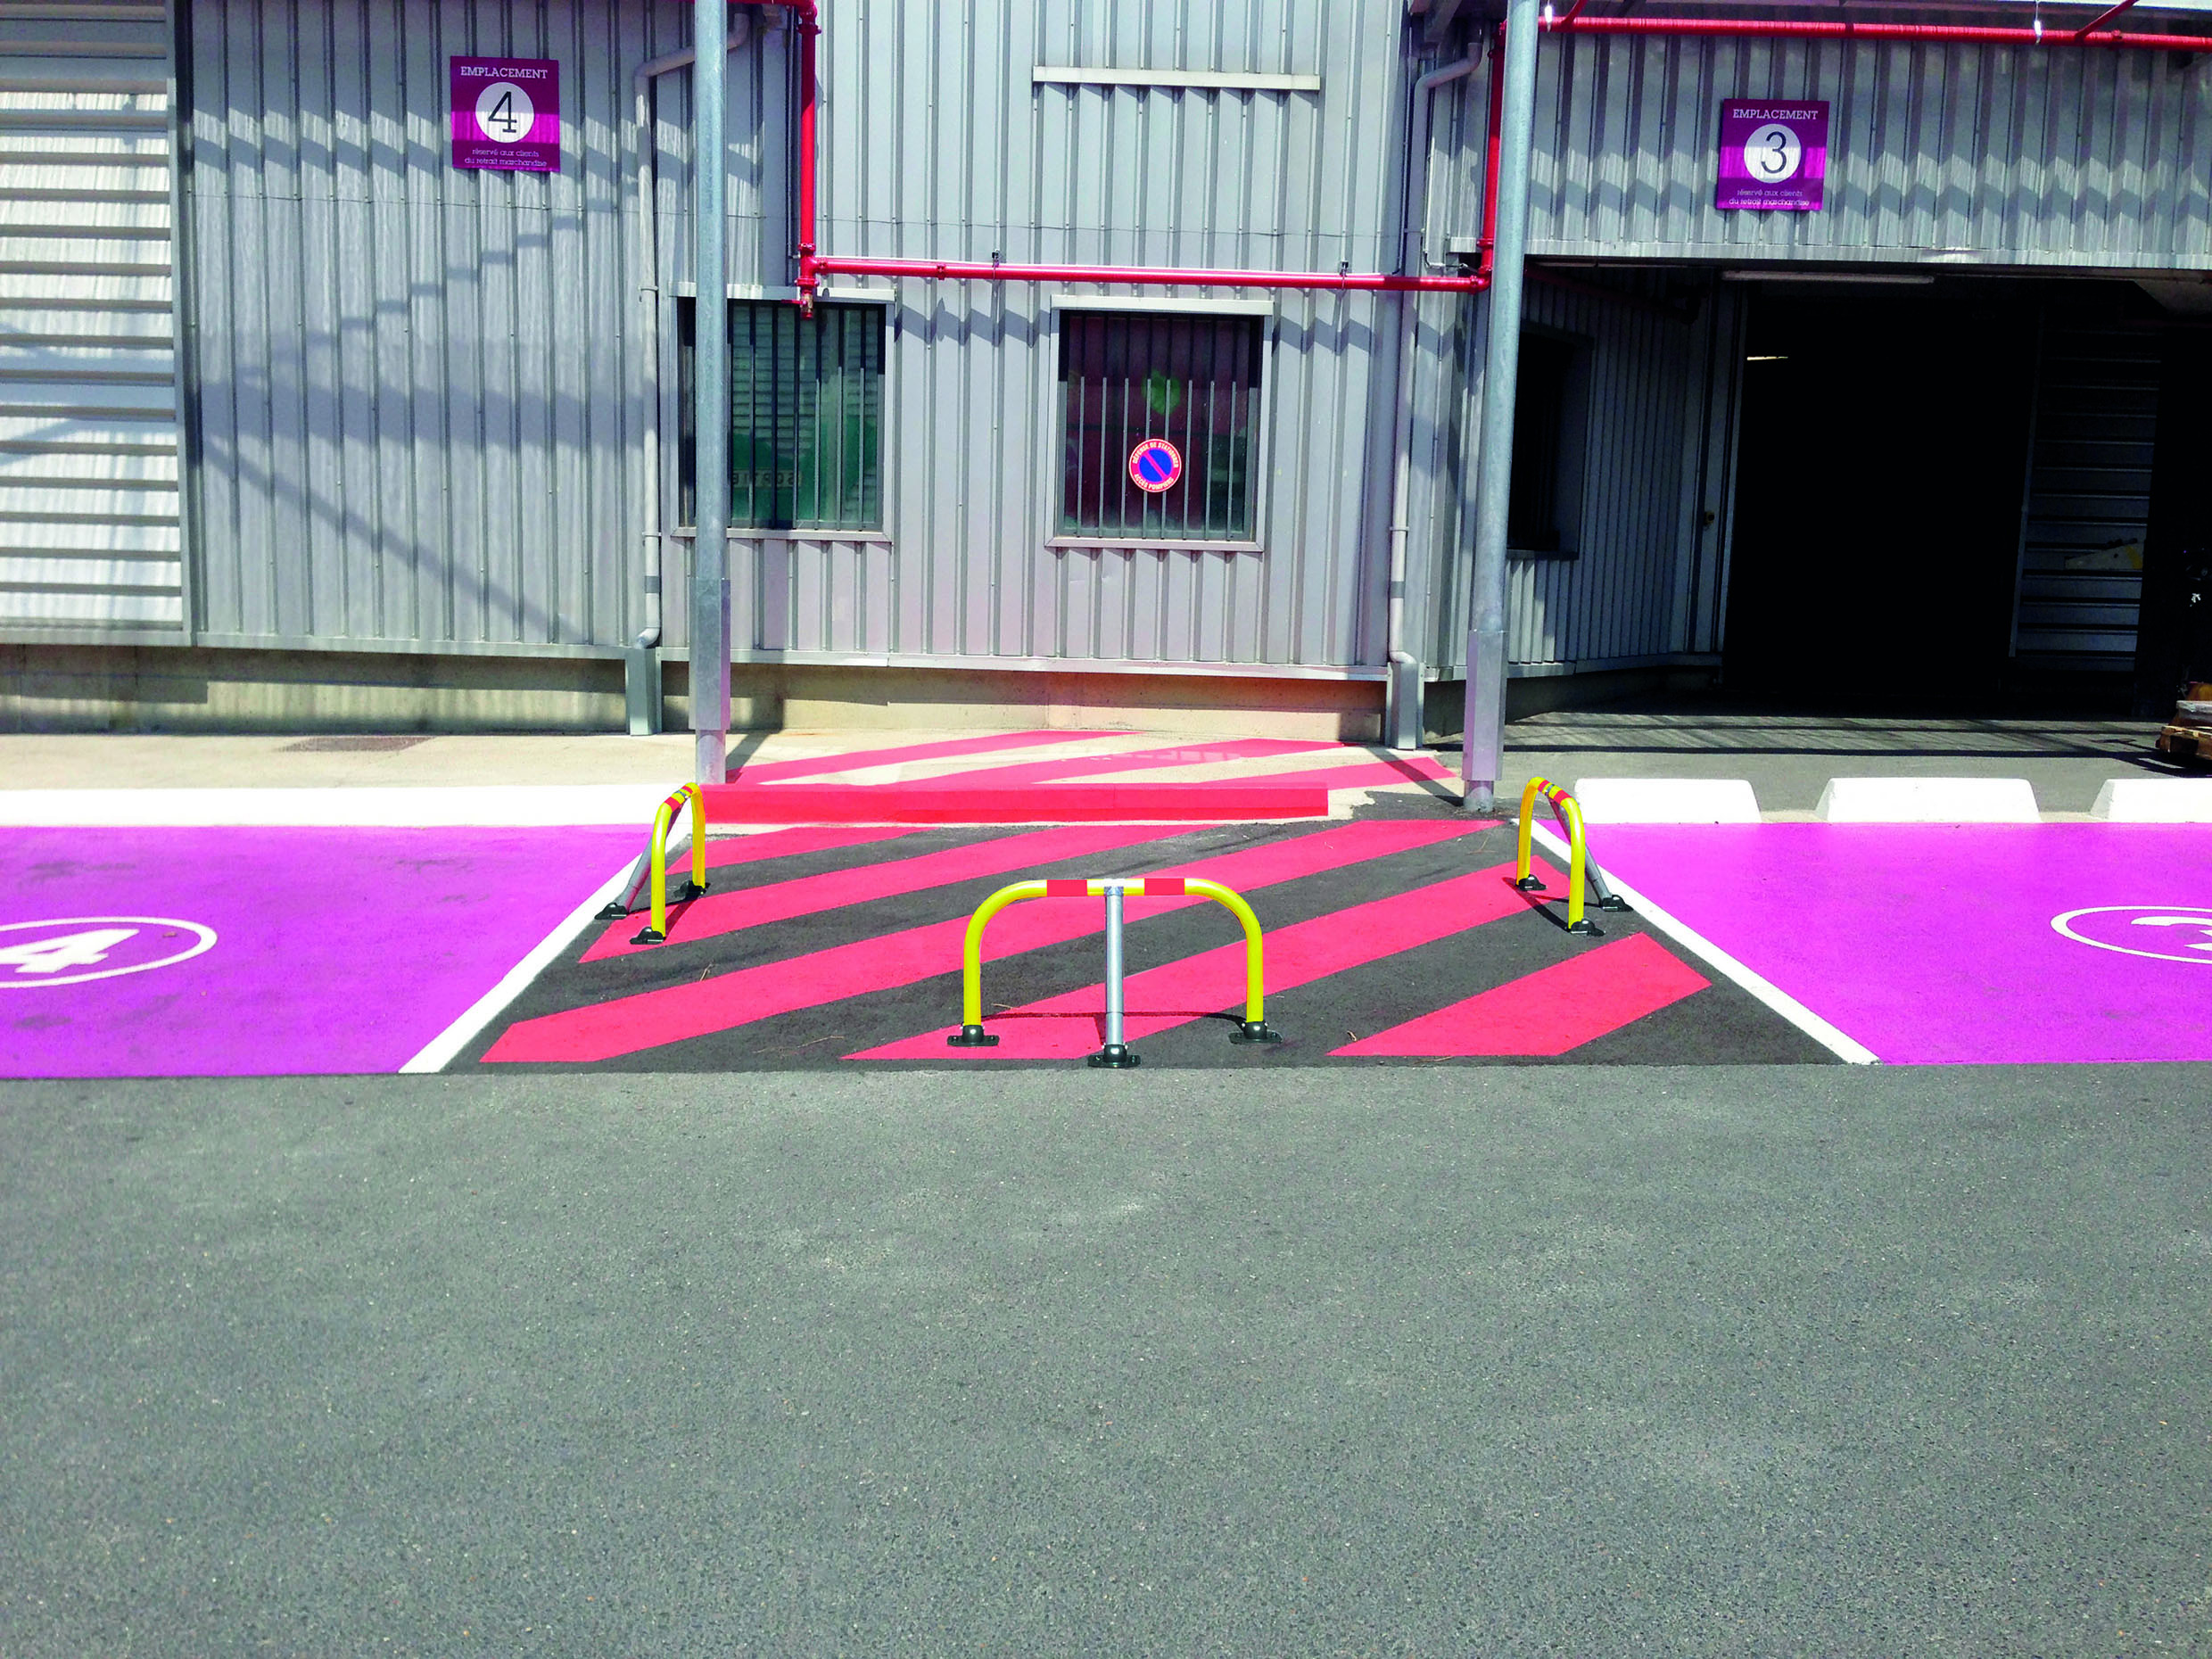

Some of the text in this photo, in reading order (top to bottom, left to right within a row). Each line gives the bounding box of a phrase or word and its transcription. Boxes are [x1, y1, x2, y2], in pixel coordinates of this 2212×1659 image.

[460, 66, 548, 78] EMPLACEMENT
[488, 91, 517, 133] 4
[1733, 109, 1819, 120] EMPLACEMENT
[472, 148, 499, 156] réservé
[1762, 131, 1787, 174] 3
[499, 159, 548, 167] marchandise
[1762, 198, 1810, 206] marchandise
[1133, 443, 1149, 464] DÉFENSE
[1158, 442, 1179, 467] STATIONNER
[0, 929, 139, 972] 4
